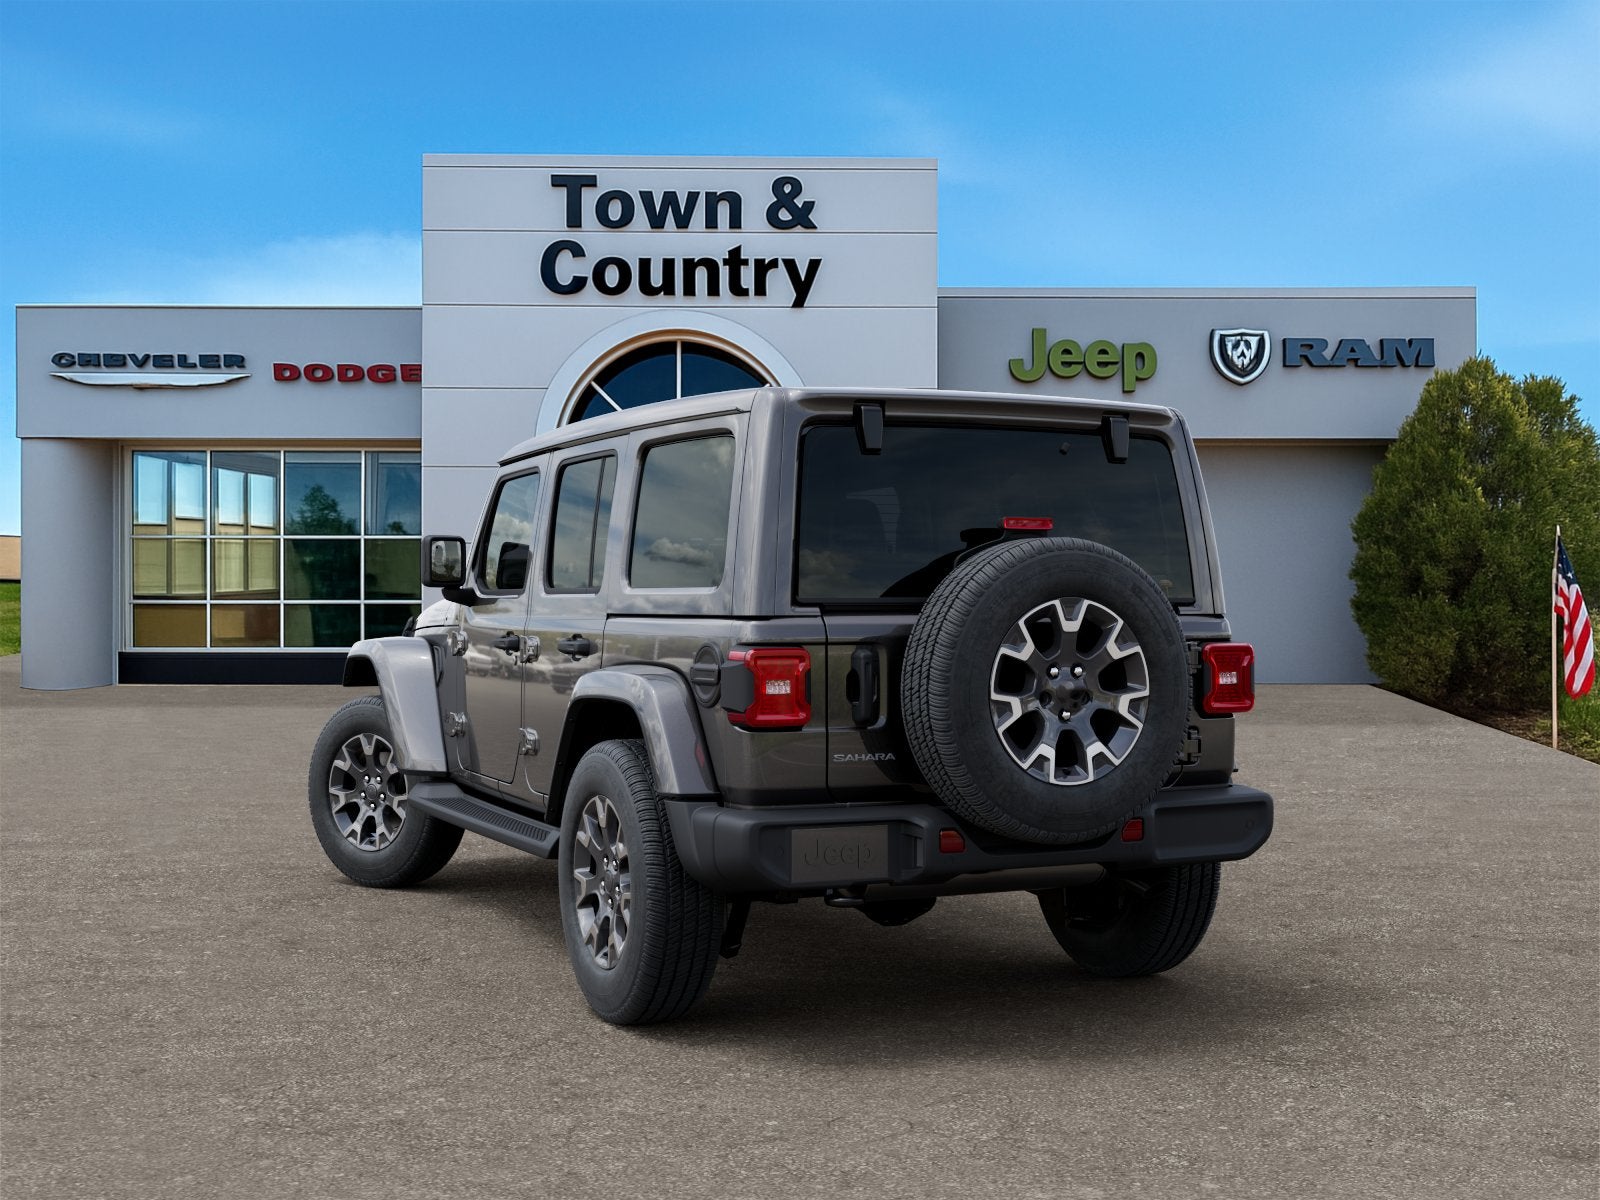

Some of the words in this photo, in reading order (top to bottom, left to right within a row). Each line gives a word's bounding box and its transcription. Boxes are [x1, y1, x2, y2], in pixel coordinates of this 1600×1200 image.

[551, 174, 742, 229] Town
[766, 176, 818, 230] &
[540, 239, 822, 308] Country
[1009, 328, 1157, 393] Jeep
[1282, 337, 1435, 367] RAM
[273, 363, 422, 382] DODGE
[833, 753, 896, 762] SAHARA
[804, 839, 872, 870] Jeep
